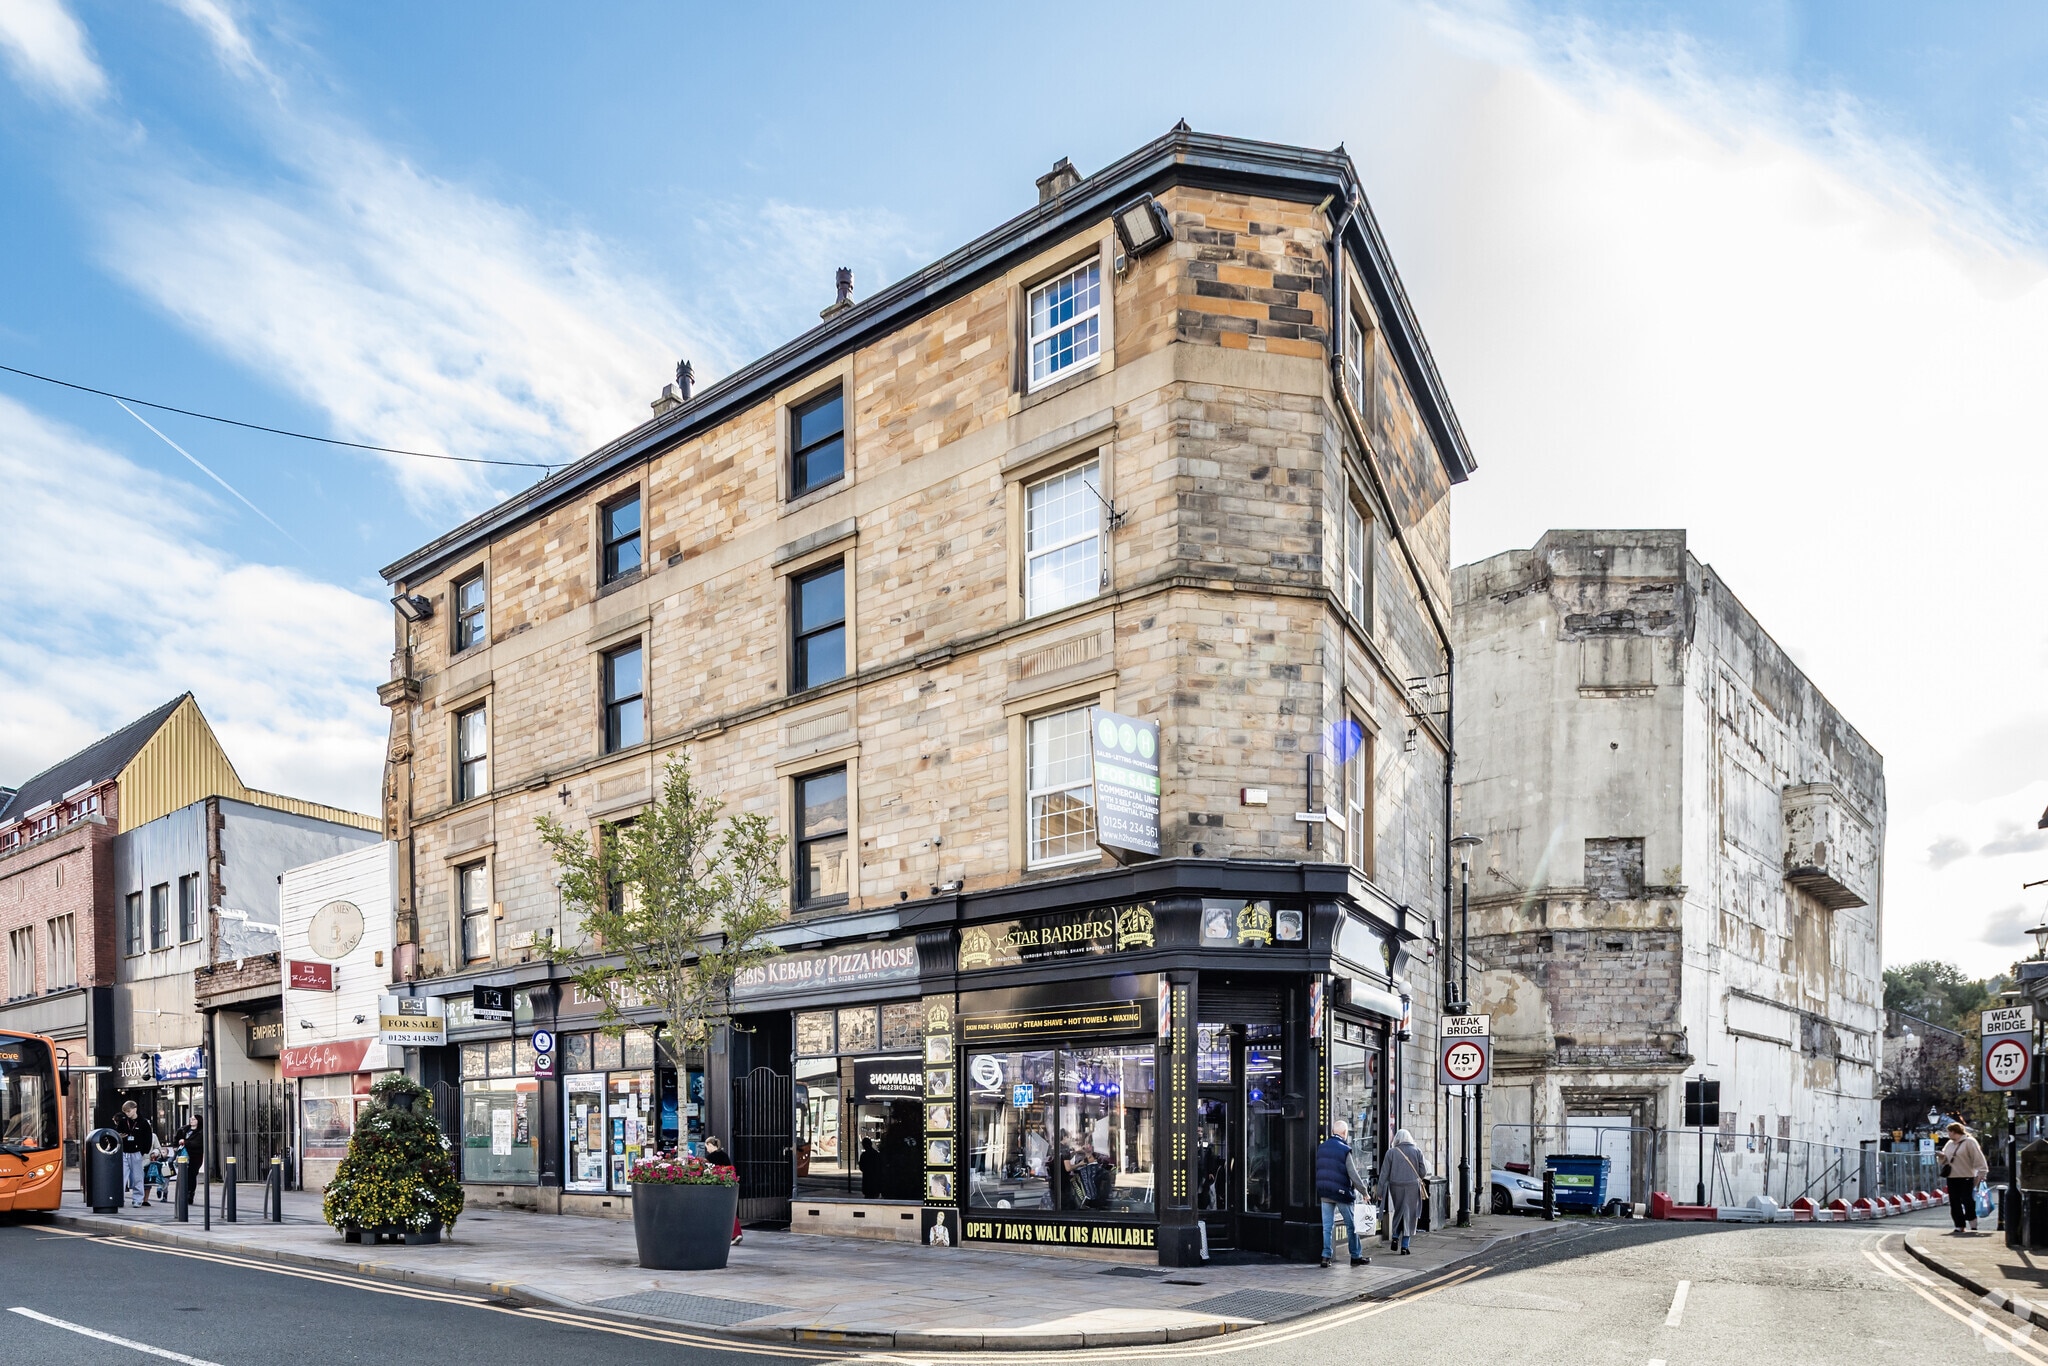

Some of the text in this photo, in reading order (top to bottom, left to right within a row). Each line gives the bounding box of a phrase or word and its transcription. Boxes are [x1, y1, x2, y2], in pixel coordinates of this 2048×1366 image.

[1100, 766, 1156, 793] FOR SALE
[1099, 783, 1159, 806] COMMERCIAL UNIT
[1099, 794, 1114, 802] WITH
[1119, 799, 1131, 807] SELF
[1132, 802, 1159, 815] CONTAINED
[1106, 803, 1153, 820] RESIDENTIAL FLATS
[1103, 816, 1158, 838] 01254 234 561
[1103, 831, 1159, 849] www.h2homes.co.uk
[1007, 919, 1113, 946] STAR BARBERS
[995, 954, 1022, 963] TRADITIONAL
[1086, 944, 1113, 952] SPECIALIST
[768, 960, 812, 982] KEBAB
[814, 958, 827, 976] &
[828, 952, 870, 975] PIZZA
[871, 946, 914, 970] HOUSE
[573, 979, 631, 1005] EMPRE
[977, 1023, 990, 1031] FADE
[993, 1021, 1019, 1030] HAIRCUT
[1023, 1020, 1043, 1028] STEAM
[1043, 1018, 1063, 1027] SHAVE
[1068, 1017, 1081, 1025] HOT
[1082, 1015, 1108, 1024] TOWELS
[1112, 1013, 1139, 1022] WAXING
[1451, 1017, 1480, 1026] WEAK
[1991, 1008, 2022, 1021] WEAK
[252, 1024, 276, 1040] EMPIRE
[388, 1019, 439, 1029] FOR SALE
[1447, 1026, 1484, 1035] BRIDGE
[1987, 1020, 2026, 1033] BRIDGE
[388, 1034, 439, 1043] 01282 414387
[284, 1051, 294, 1069] The
[295, 1051, 308, 1067] Last
[308, 1046, 322, 1070] Stop
[967, 1222, 1155, 1246] OPEN 7 DAYS WALK INS AVAILABLE
